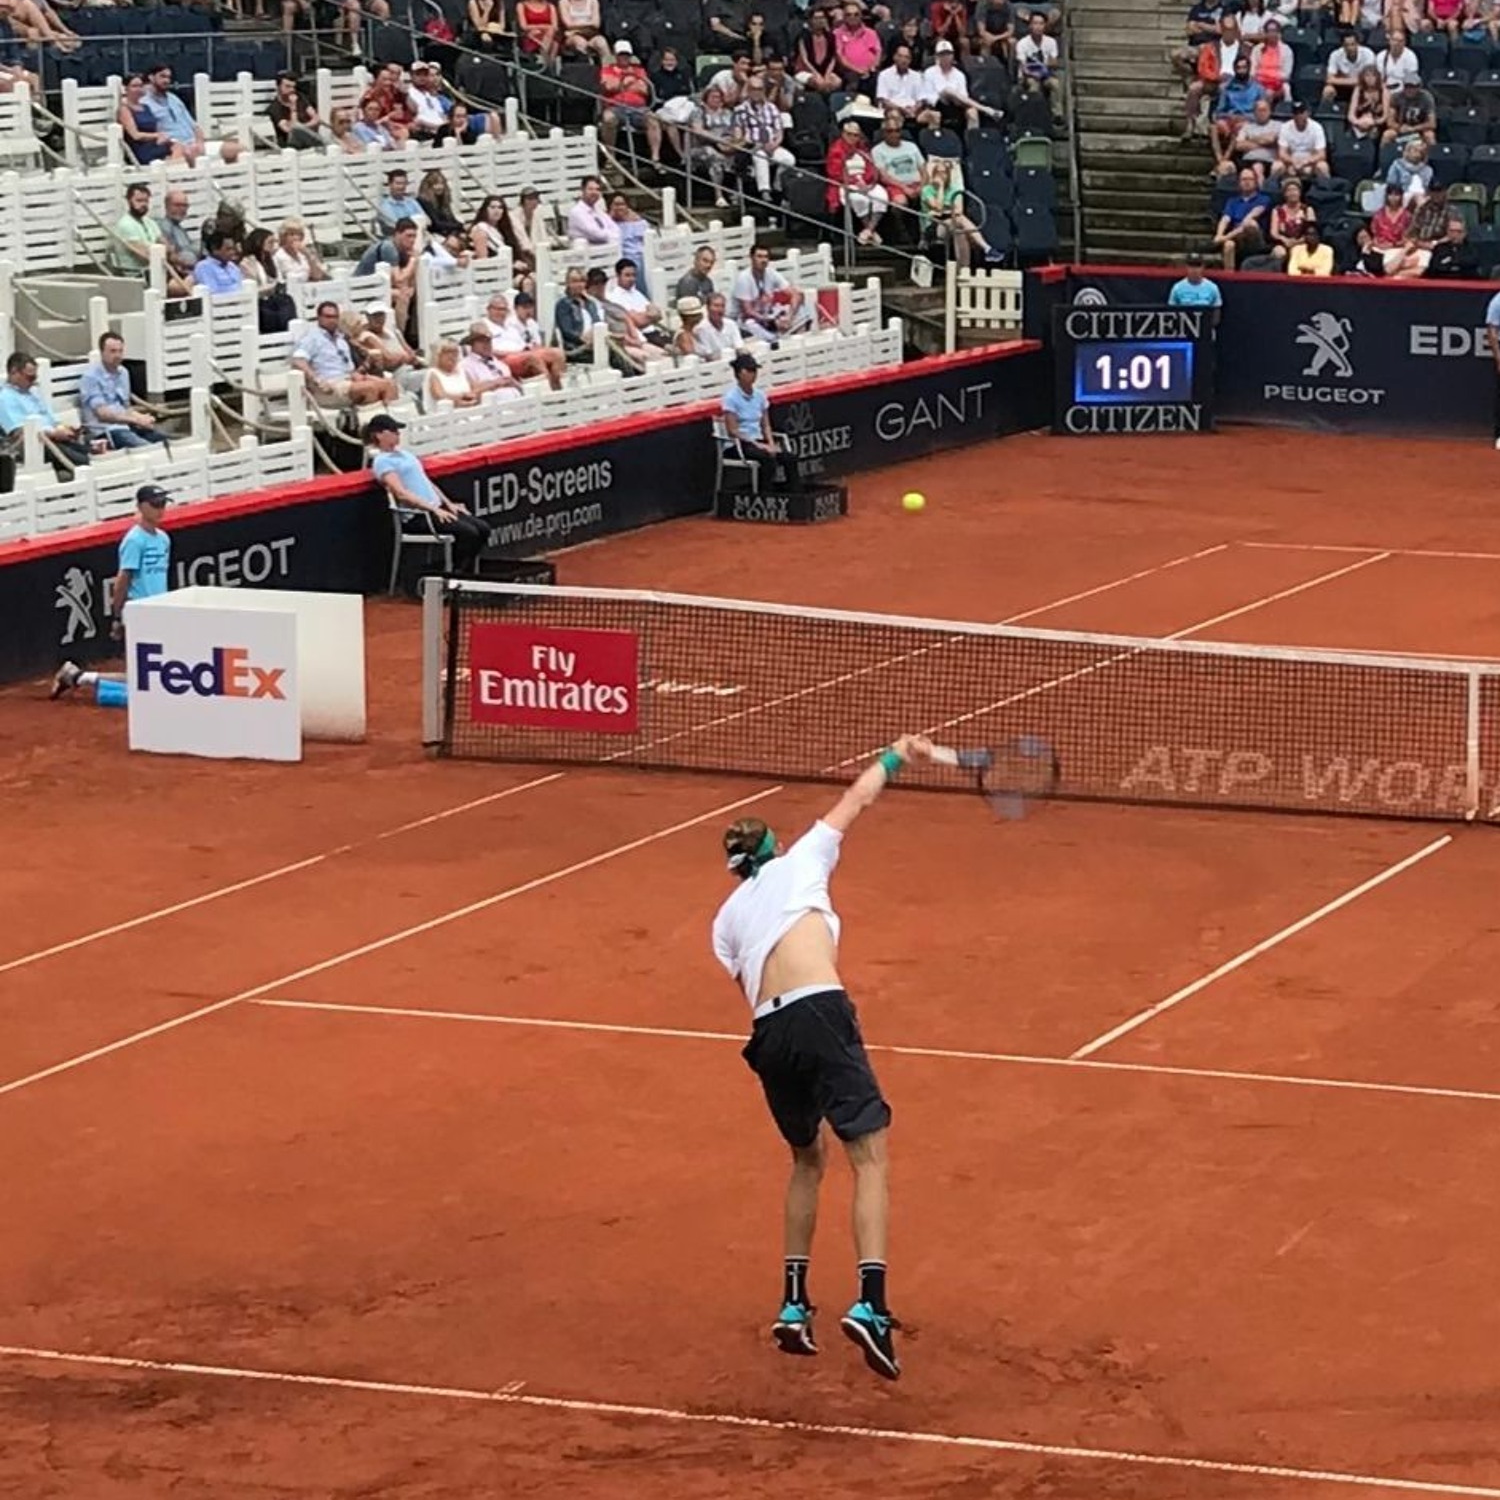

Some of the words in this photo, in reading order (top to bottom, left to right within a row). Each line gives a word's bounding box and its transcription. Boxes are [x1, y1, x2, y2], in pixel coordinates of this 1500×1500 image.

[1065, 311, 1203, 340] CITIZEN
[1095, 354, 1171, 391] 1:01
[1264, 384, 1386, 405] PEUGEOT
[875, 381, 993, 442] GANT
[1065, 404, 1202, 433] CITIZEN
[474, 459, 613, 518] LED-Screens
[734, 494, 790, 510] MARY
[488, 502, 602, 548] www.de.prg.com
[103, 537, 296, 616] PGEOT
[136, 642, 286, 700] FedEx
[531, 645, 576, 677] Fly
[479, 668, 630, 715] Emirates
[1119, 746, 1275, 796] ATP
